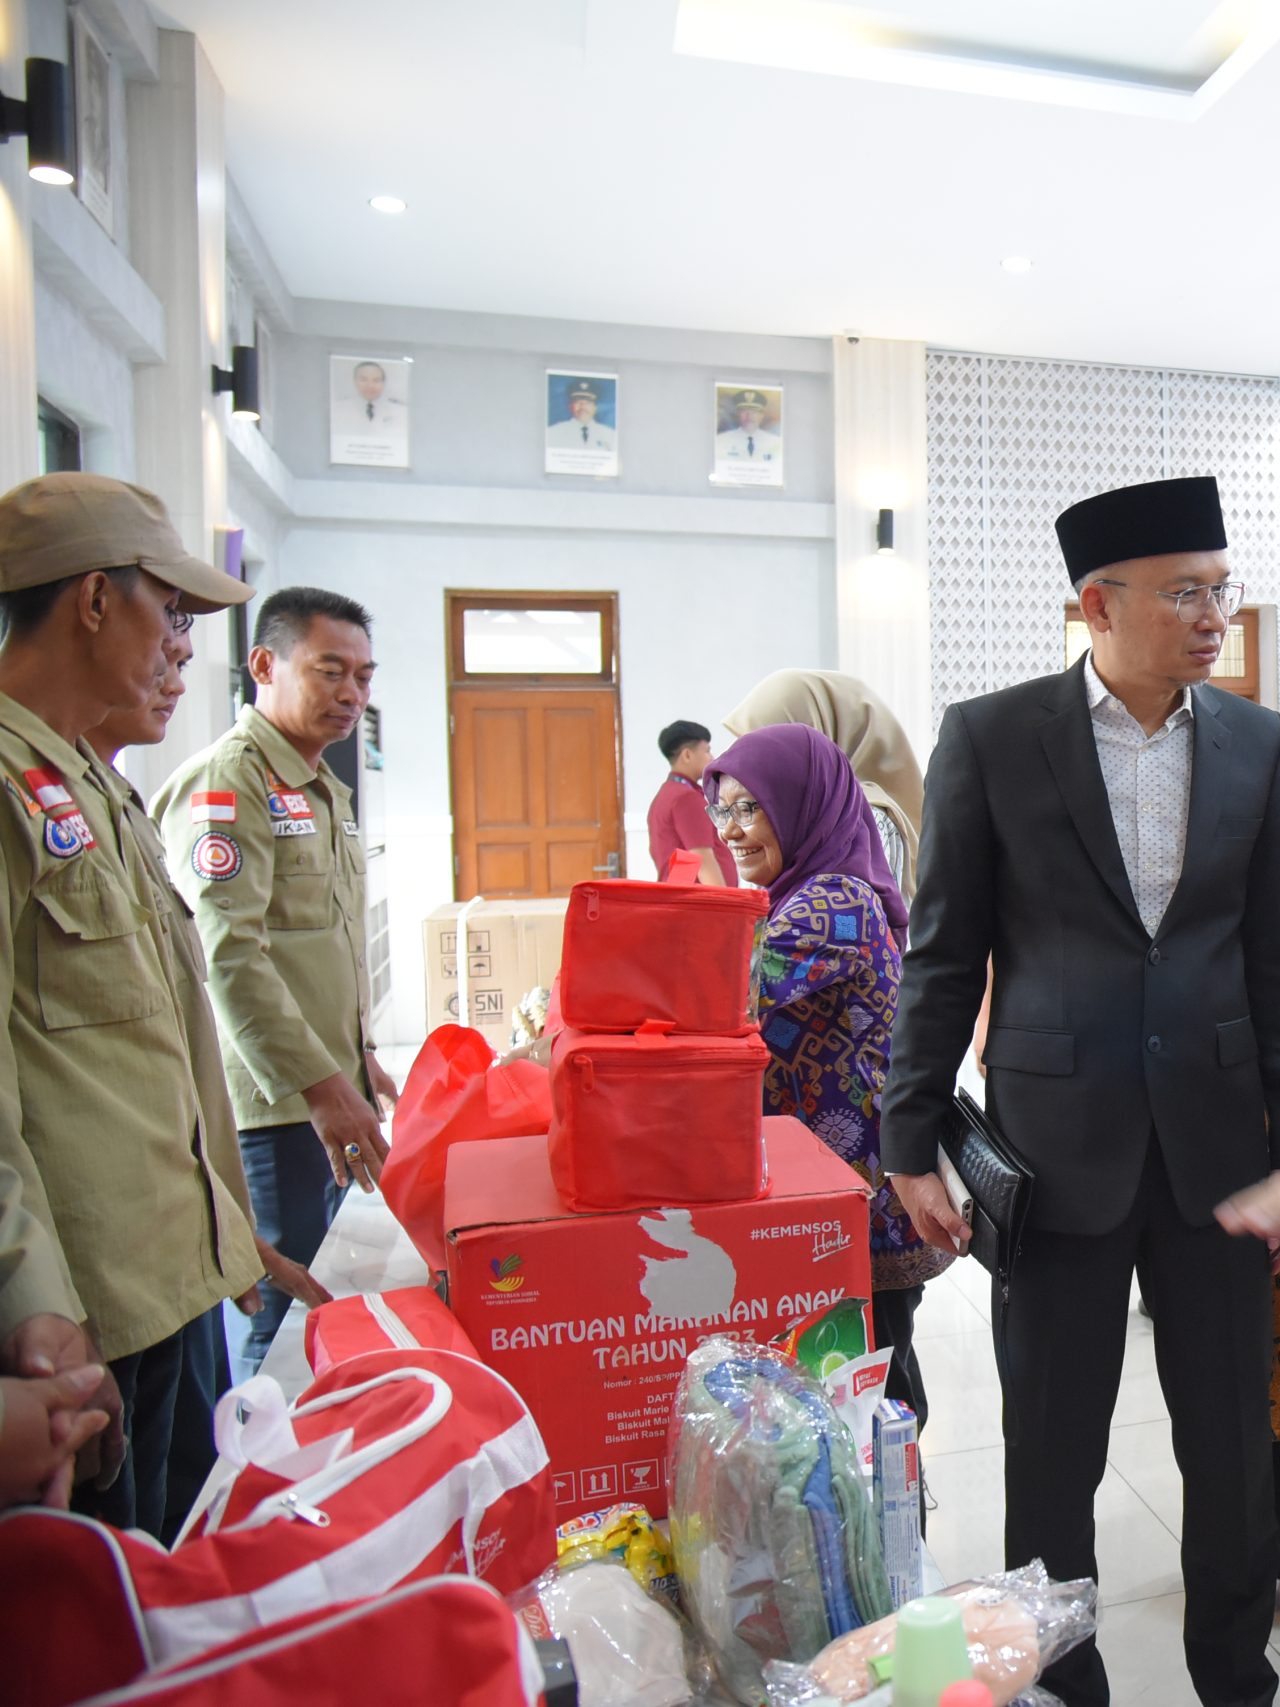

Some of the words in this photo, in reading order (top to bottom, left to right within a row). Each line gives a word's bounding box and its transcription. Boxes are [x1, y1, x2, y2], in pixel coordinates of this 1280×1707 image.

[475, 993, 503, 1012] SNI
[751, 1220, 841, 1240] #KEMENSOS
[812, 1230, 851, 1255] Hadir
[491, 1316, 625, 1351] BANTUAN
[776, 1287, 846, 1318] ANAK
[593, 1337, 686, 1370] TAHUN
[603, 1380, 632, 1389] Nomor
[607, 1409, 641, 1421] Biskuit
[643, 1406, 669, 1416] Marie
[617, 1420, 651, 1431] Biskuit
[605, 1432, 639, 1445] Biskuit
[641, 1429, 665, 1439] Rasa
